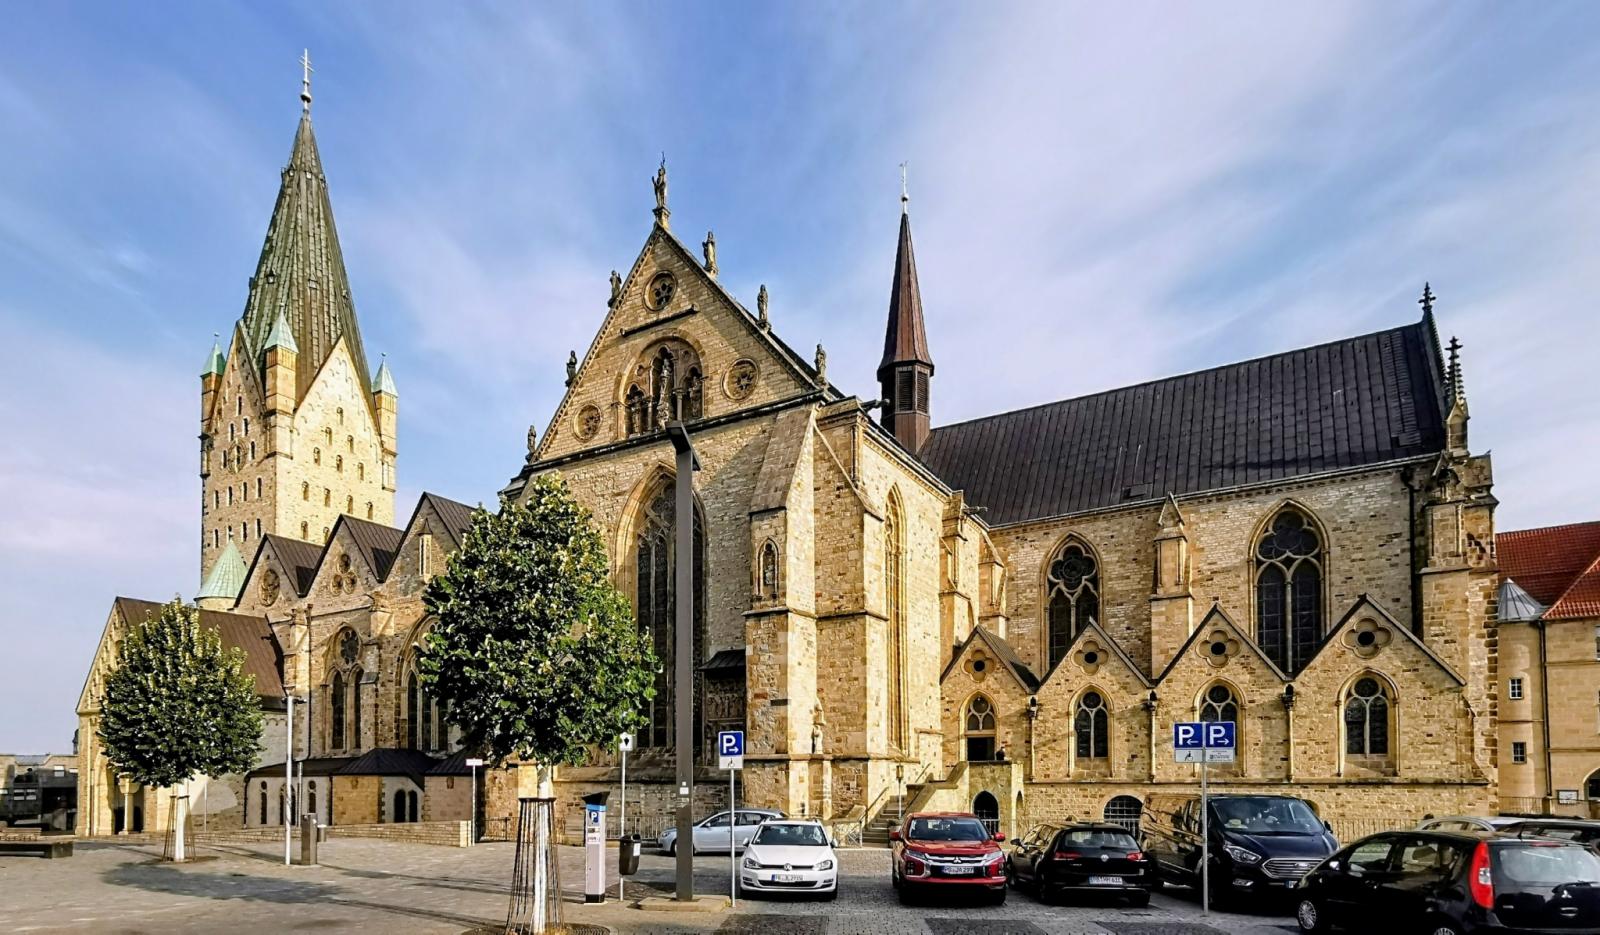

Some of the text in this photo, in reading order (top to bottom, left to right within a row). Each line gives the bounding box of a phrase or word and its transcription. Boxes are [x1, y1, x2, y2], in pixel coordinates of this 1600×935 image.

[722, 734, 736, 754] P
[1178, 725, 1195, 746] P
[1209, 725, 1226, 746] P
[591, 811, 598, 821] P
